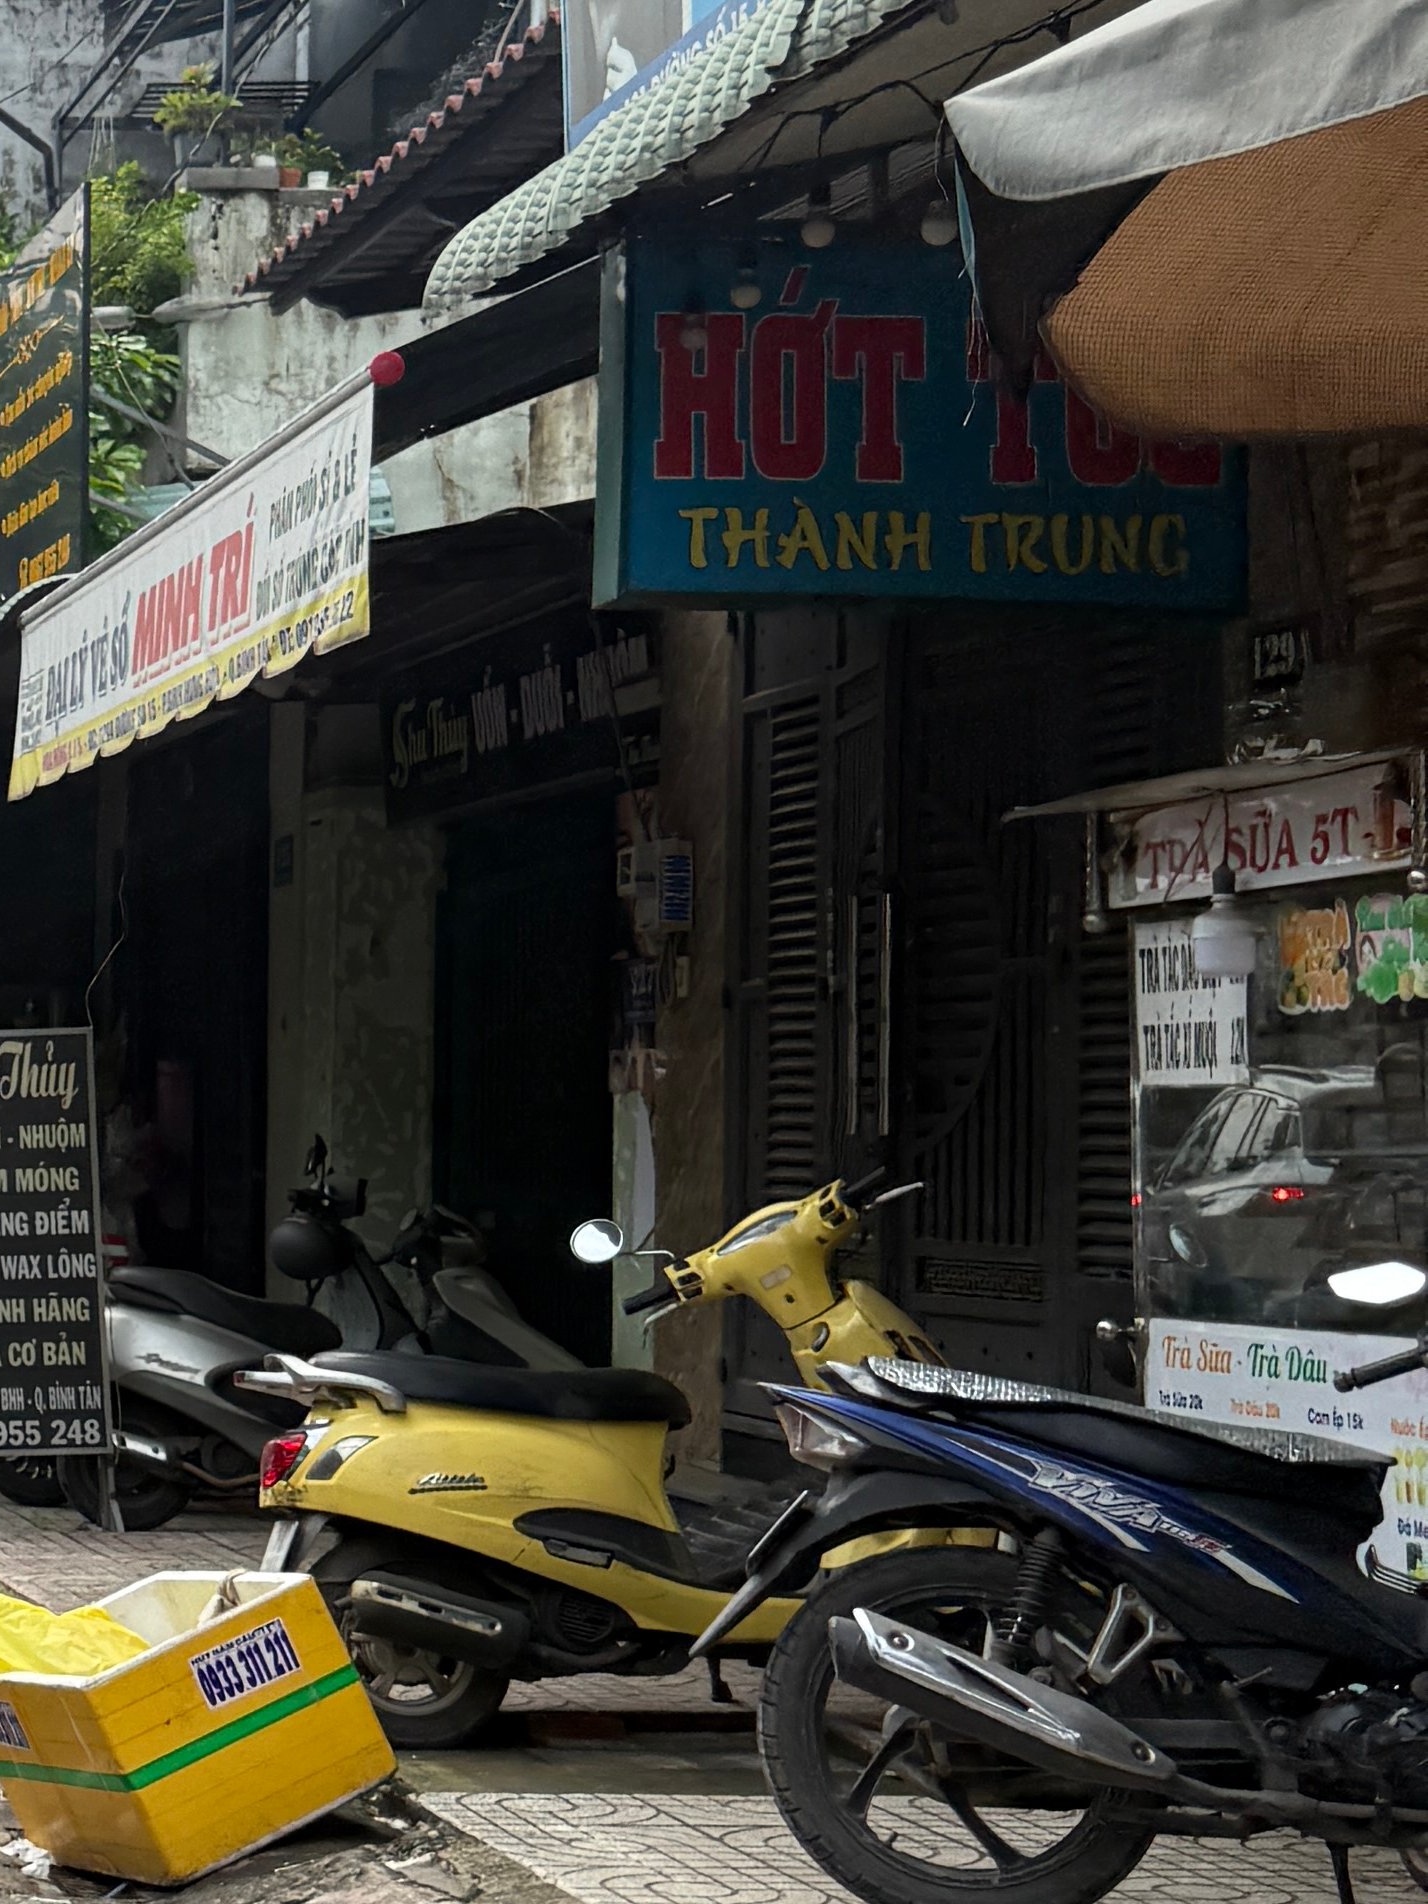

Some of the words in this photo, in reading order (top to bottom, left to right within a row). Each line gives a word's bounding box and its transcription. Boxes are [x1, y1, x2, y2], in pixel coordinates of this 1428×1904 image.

[653, 265, 926, 483] HỚT
[678, 497, 934, 571] THÀNH
[959, 510, 1191, 578] TRUNG
[131, 552, 204, 686] MINH
[208, 492, 257, 644] TRÍ
[18, 1117, 87, 1152] NHUỘM
[14, 1161, 80, 1193] MÓNG
[34, 1198, 90, 1236] ĐIỂM
[0, 1255, 41, 1280] WAX
[47, 1247, 97, 1280] LÔNG
[32, 1291, 90, 1323] HÃNG
[7, 1337, 38, 1368] CƠ
[42, 1331, 87, 1367] BẢN
[1246, 1342, 1279, 1380] Trà
[1284, 1345, 1328, 1385] Dâu
[48, 1380, 76, 1410] BÌNH
[78, 1379, 103, 1410] TÂN
[50, 1418, 101, 1446] 248
